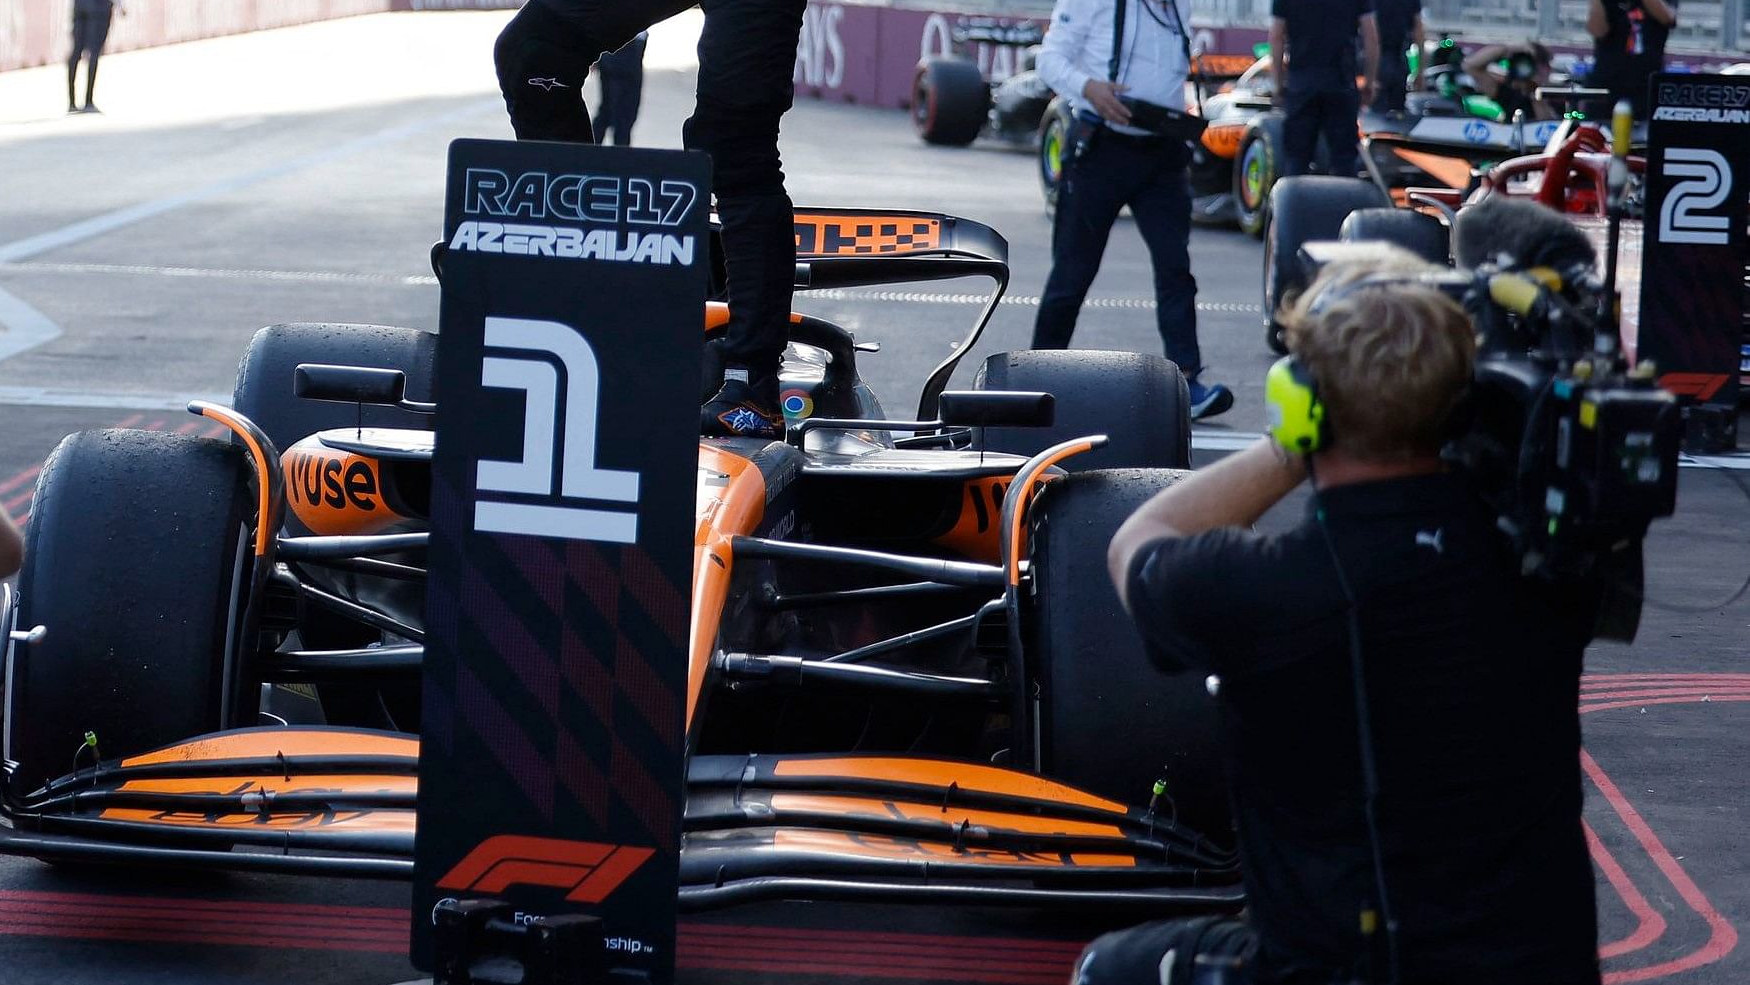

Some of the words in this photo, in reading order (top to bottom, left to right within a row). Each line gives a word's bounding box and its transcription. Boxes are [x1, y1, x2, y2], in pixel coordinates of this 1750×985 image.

[1652, 106, 1750, 124] AZERBAIJAN
[1658, 82, 1722, 106] RACE
[464, 168, 620, 222] RACE
[626, 178, 697, 227] 17
[1658, 147, 1733, 245] 2
[449, 221, 695, 266] AZERBAIJAN
[472, 316, 640, 546] 1
[290, 452, 377, 512] vuse
